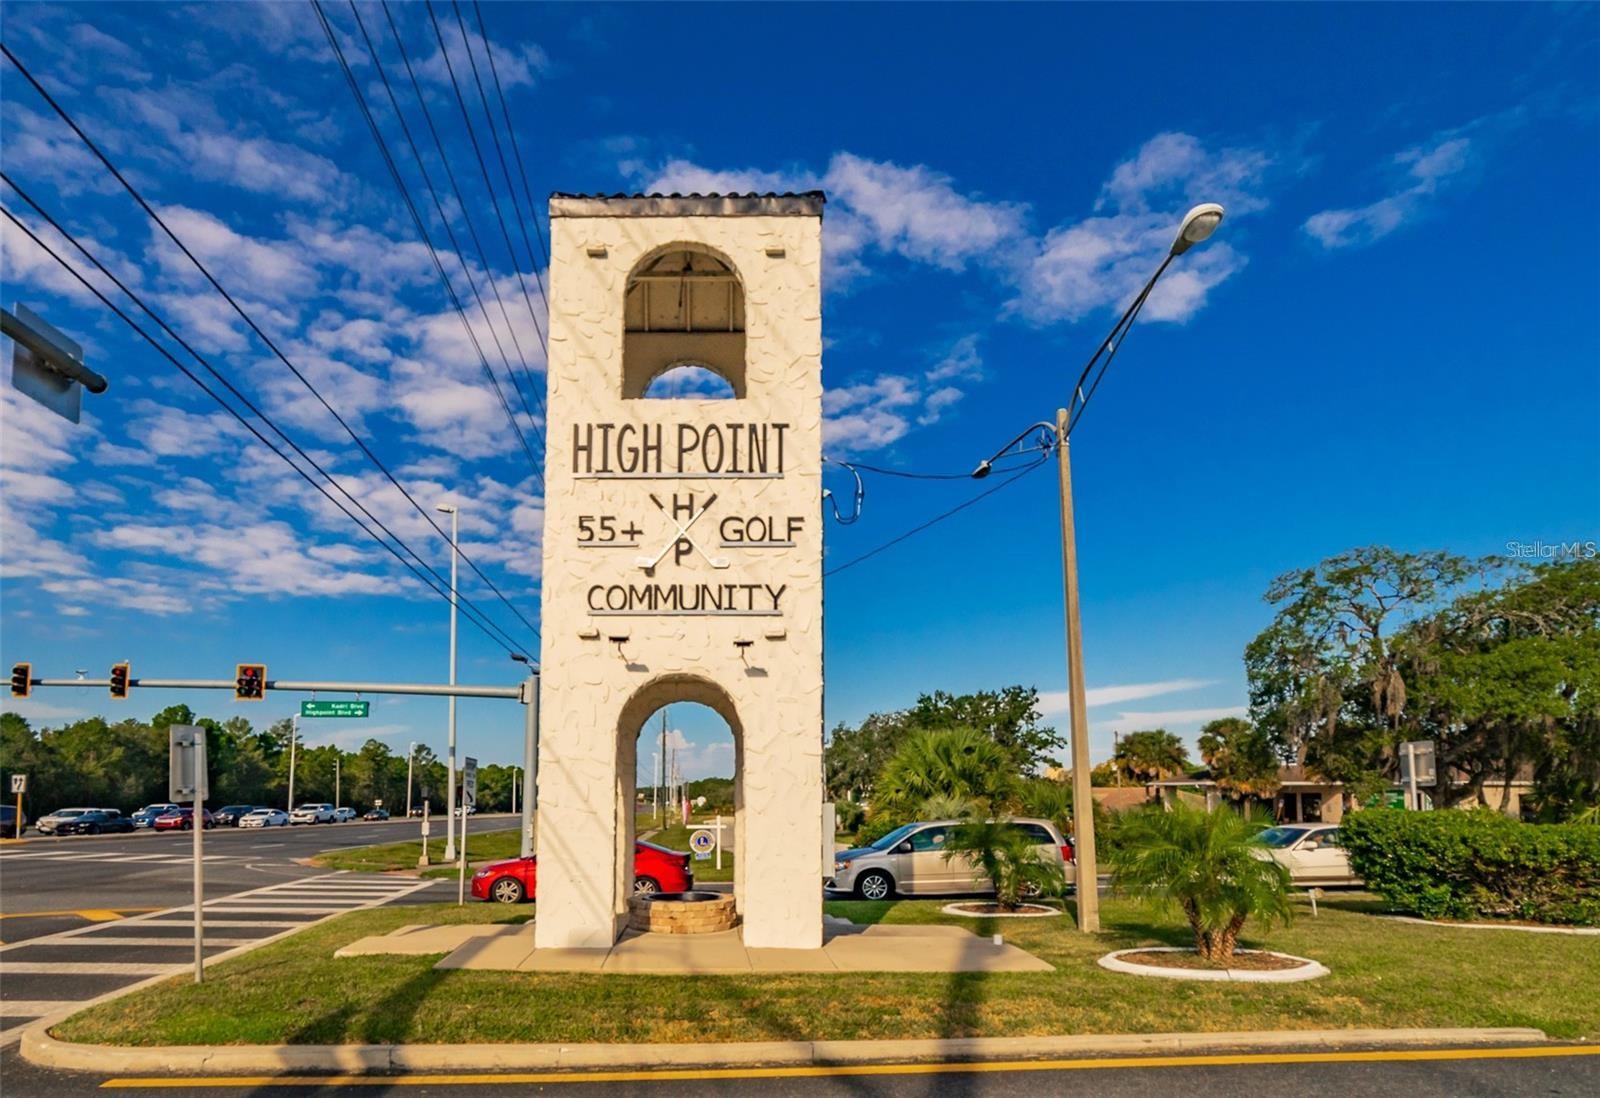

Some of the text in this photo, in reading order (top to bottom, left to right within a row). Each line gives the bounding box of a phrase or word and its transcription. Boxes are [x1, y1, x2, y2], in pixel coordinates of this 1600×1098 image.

[572, 423, 790, 474] HIGH POINT
[673, 493, 694, 520] H
[577, 515, 644, 542] 55+
[719, 516, 805, 542] GOLF
[675, 537, 693, 566] P
[587, 584, 787, 611] COMMUNITY
